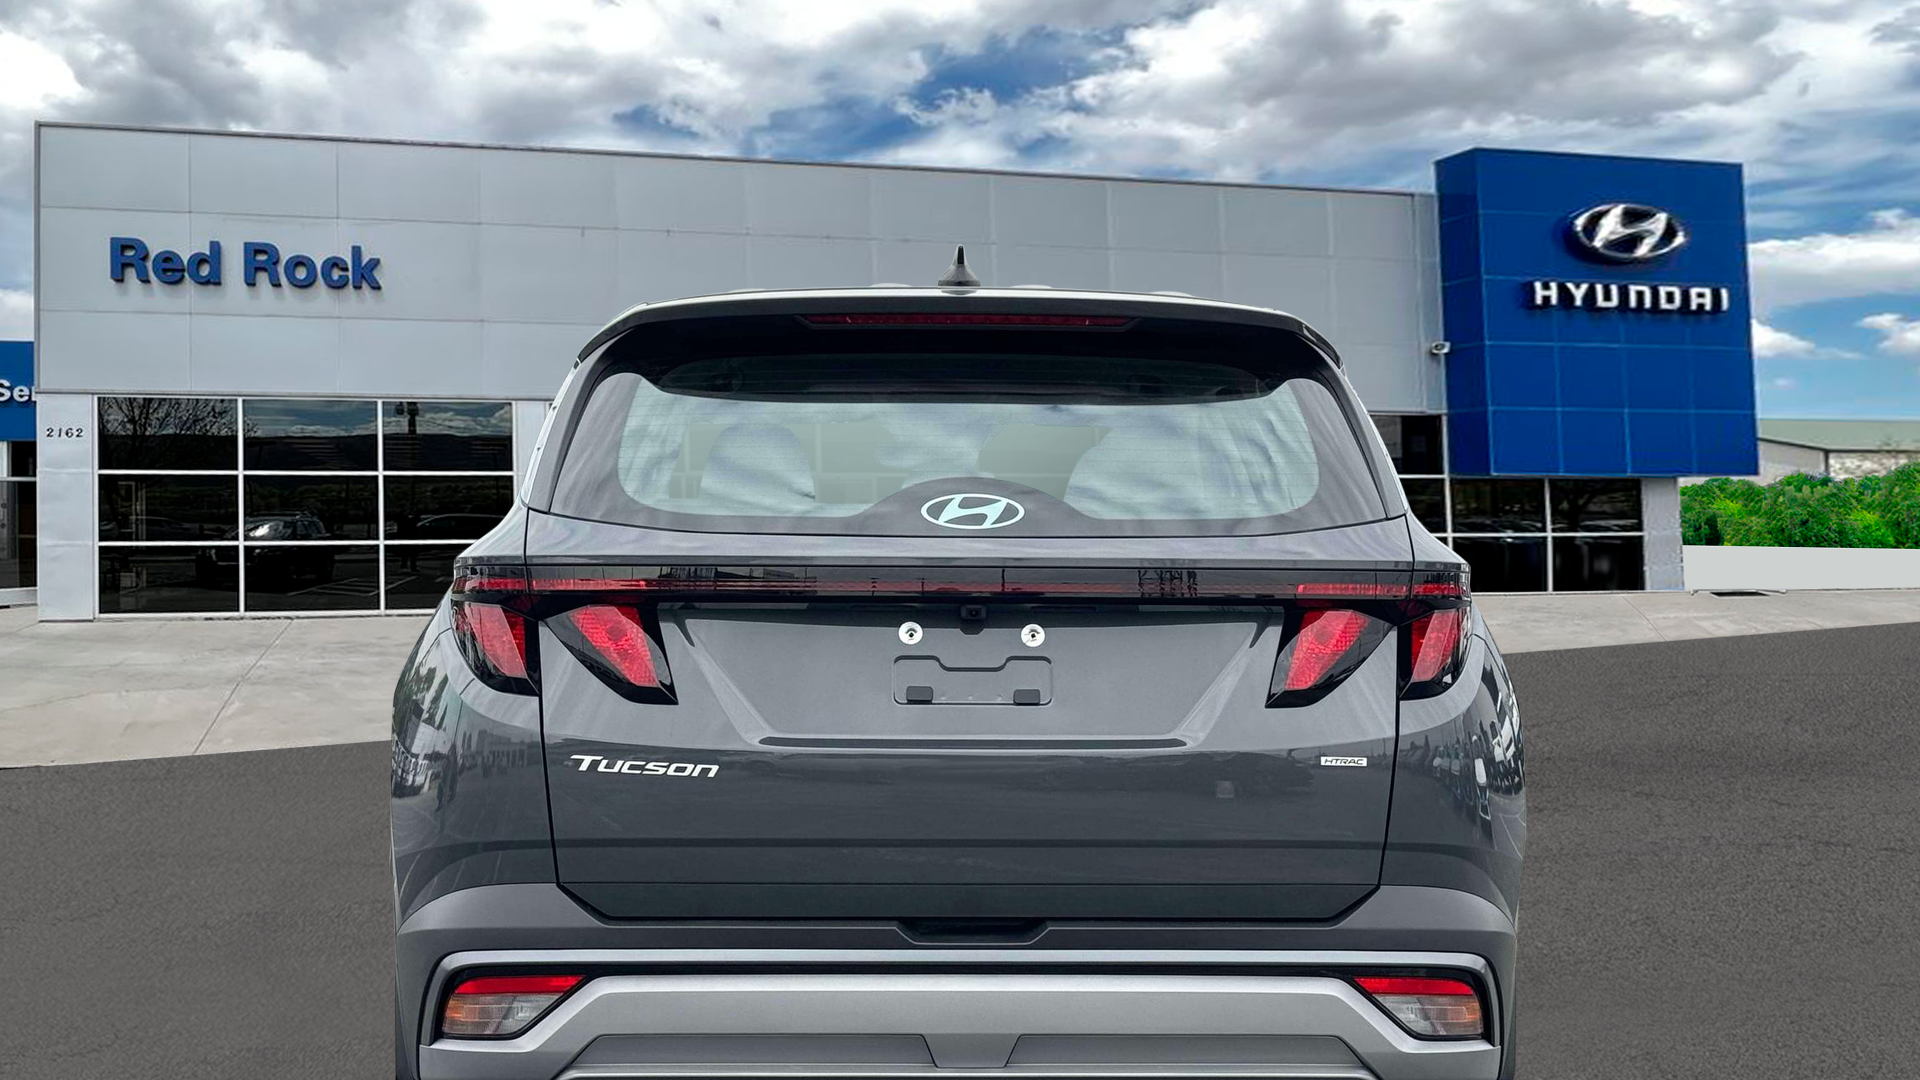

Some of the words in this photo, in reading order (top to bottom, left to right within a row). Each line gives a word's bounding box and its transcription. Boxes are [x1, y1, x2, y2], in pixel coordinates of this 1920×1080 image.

[110, 237, 222, 285] Red
[243, 241, 381, 290] Rock
[1533, 281, 1729, 311] HYUNDAI
[46, 427, 83, 438] 2162
[1323, 758, 1365, 766] HTRAC
